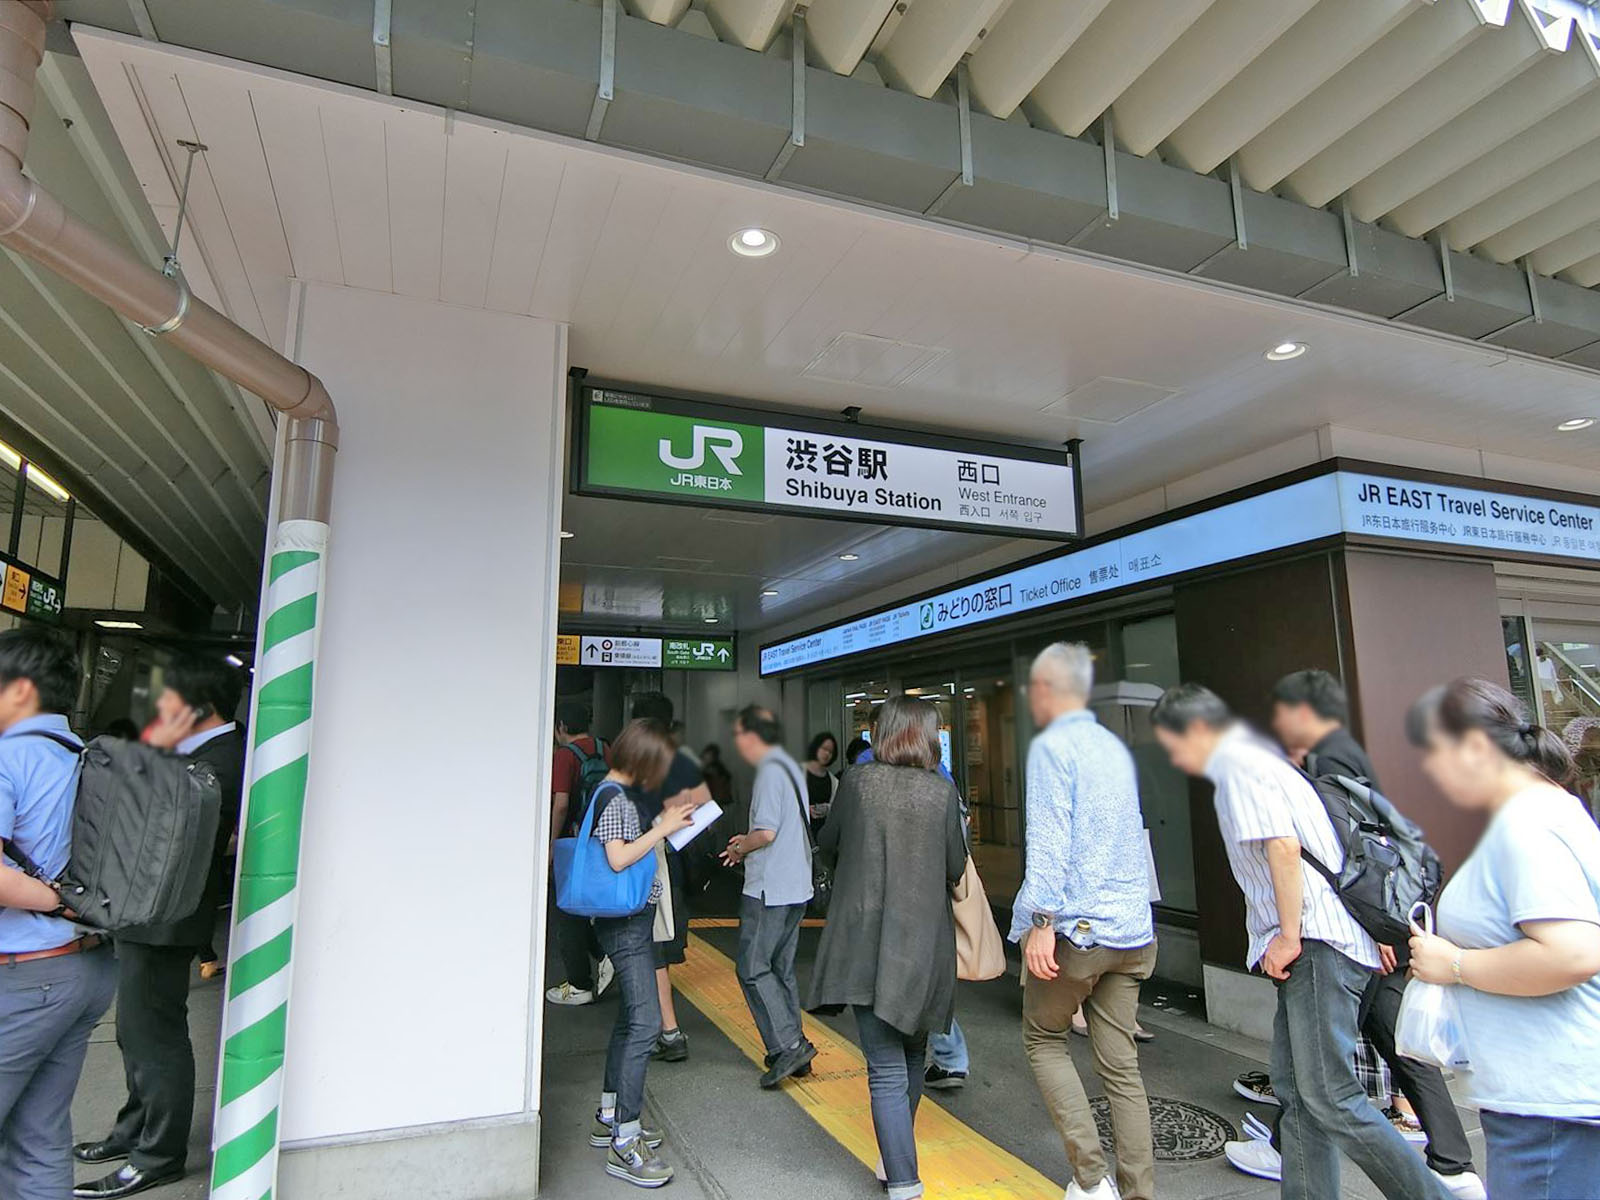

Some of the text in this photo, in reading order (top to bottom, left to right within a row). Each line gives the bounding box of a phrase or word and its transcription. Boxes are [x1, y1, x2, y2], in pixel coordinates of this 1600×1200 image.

[659, 425, 743, 476] JR
[785, 437, 888, 481] 渋谷駅
[670, 472, 733, 491] JR東日本
[957, 459, 1000, 486] 西口
[786, 478, 942, 511] Shibuya Station
[958, 487, 1047, 508] West Entrance
[1358, 482, 1593, 531] JR EAST Travel Service Center
[959, 504, 991, 518] 西入口
[1088, 564, 1119, 585] 售票处
[1128, 554, 1162, 573] 매표소
[1020, 576, 1081, 604] Ticket Office
[937, 583, 1013, 622] みどりの窓口
[692, 643, 714, 656] JR
[806, 637, 822, 649] Center
